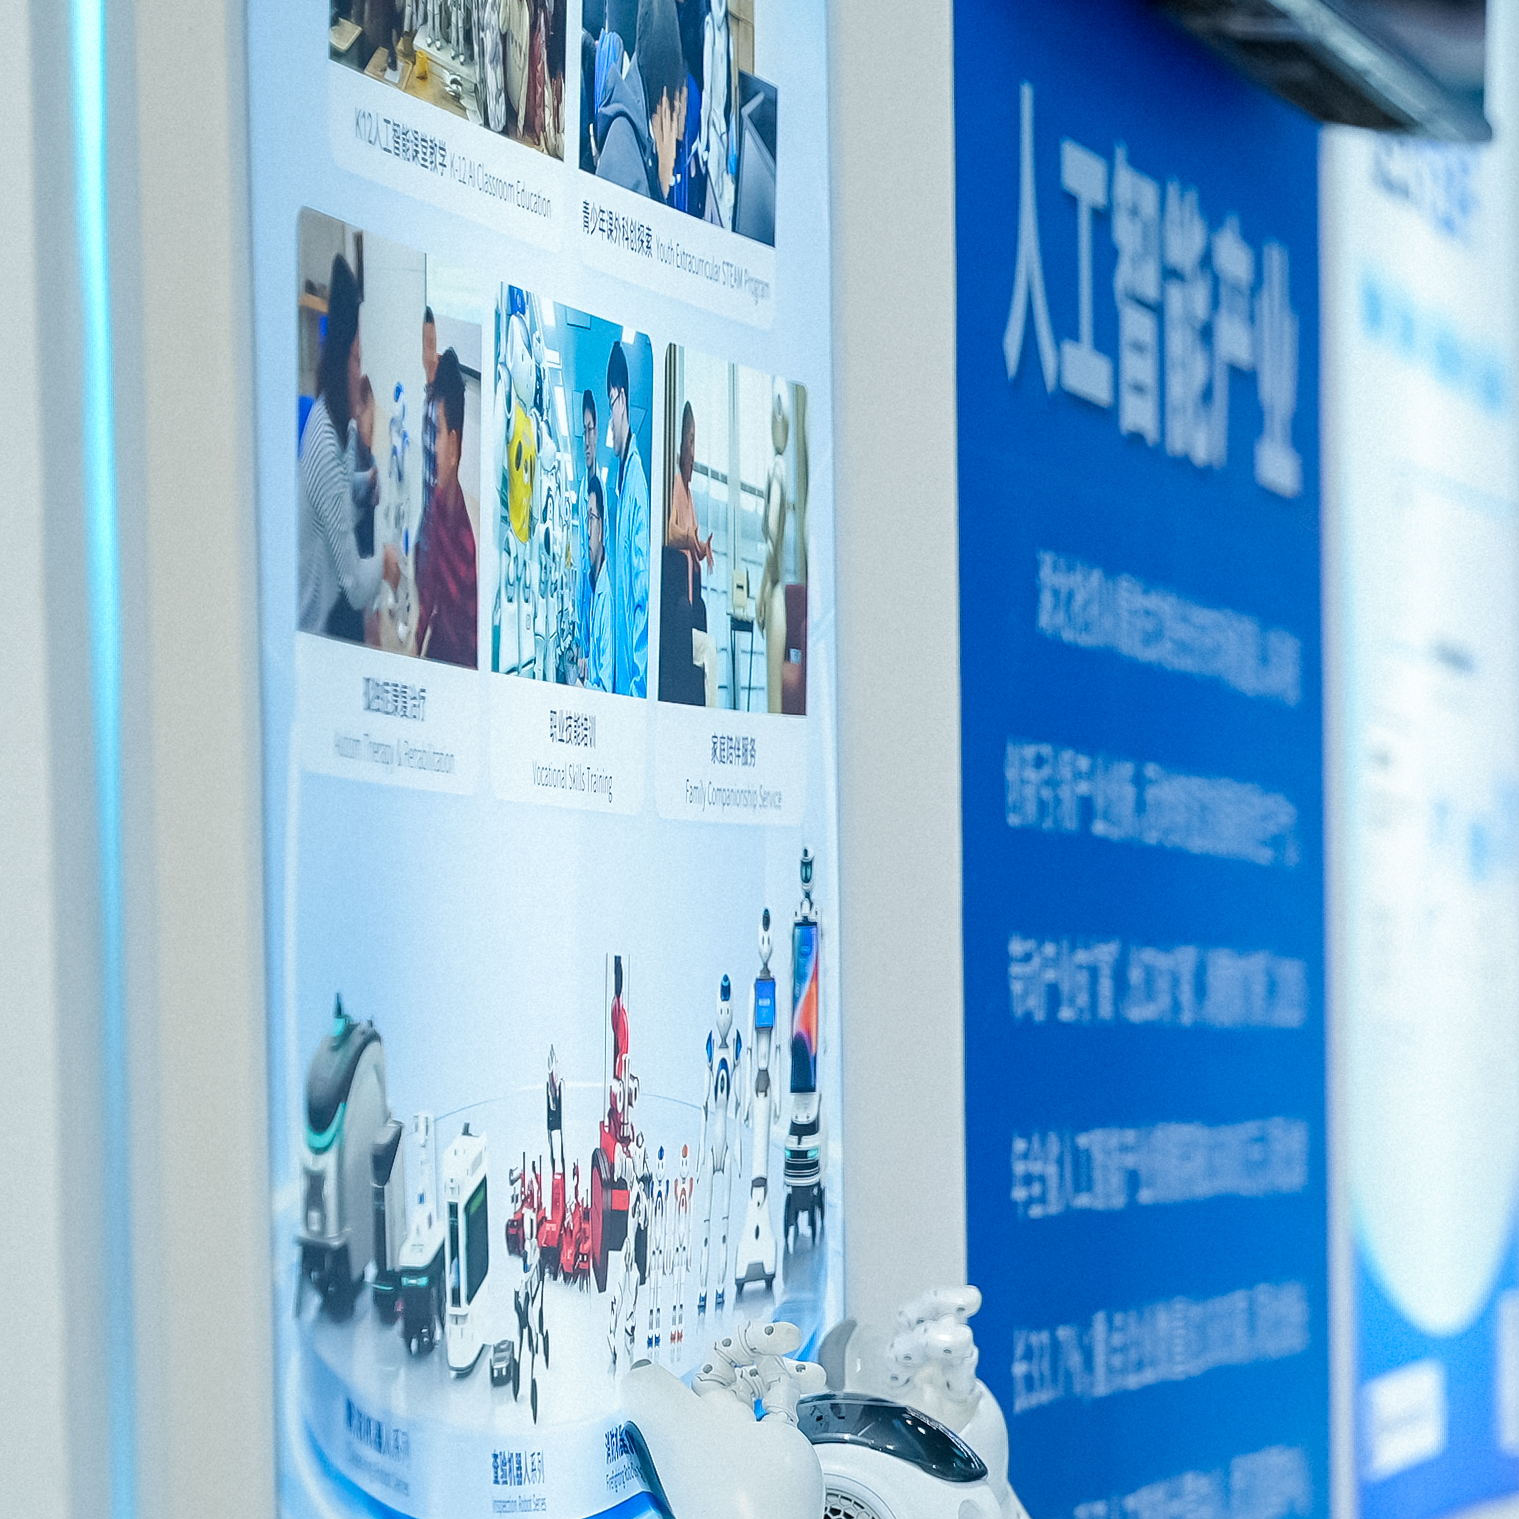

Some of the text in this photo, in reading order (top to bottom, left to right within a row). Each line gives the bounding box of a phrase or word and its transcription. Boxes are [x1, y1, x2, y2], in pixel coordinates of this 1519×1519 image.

[477, 162, 515, 204] Classroom
[517, 179, 552, 219] Education
[583, 200, 653, 258] 青少年课外科创探索
[549, 709, 597, 749] 职业技能培训
[710, 732, 757, 768] 家庭陪伴服务
[531, 759, 567, 791] Vocational
[586, 765, 613, 802] Training
